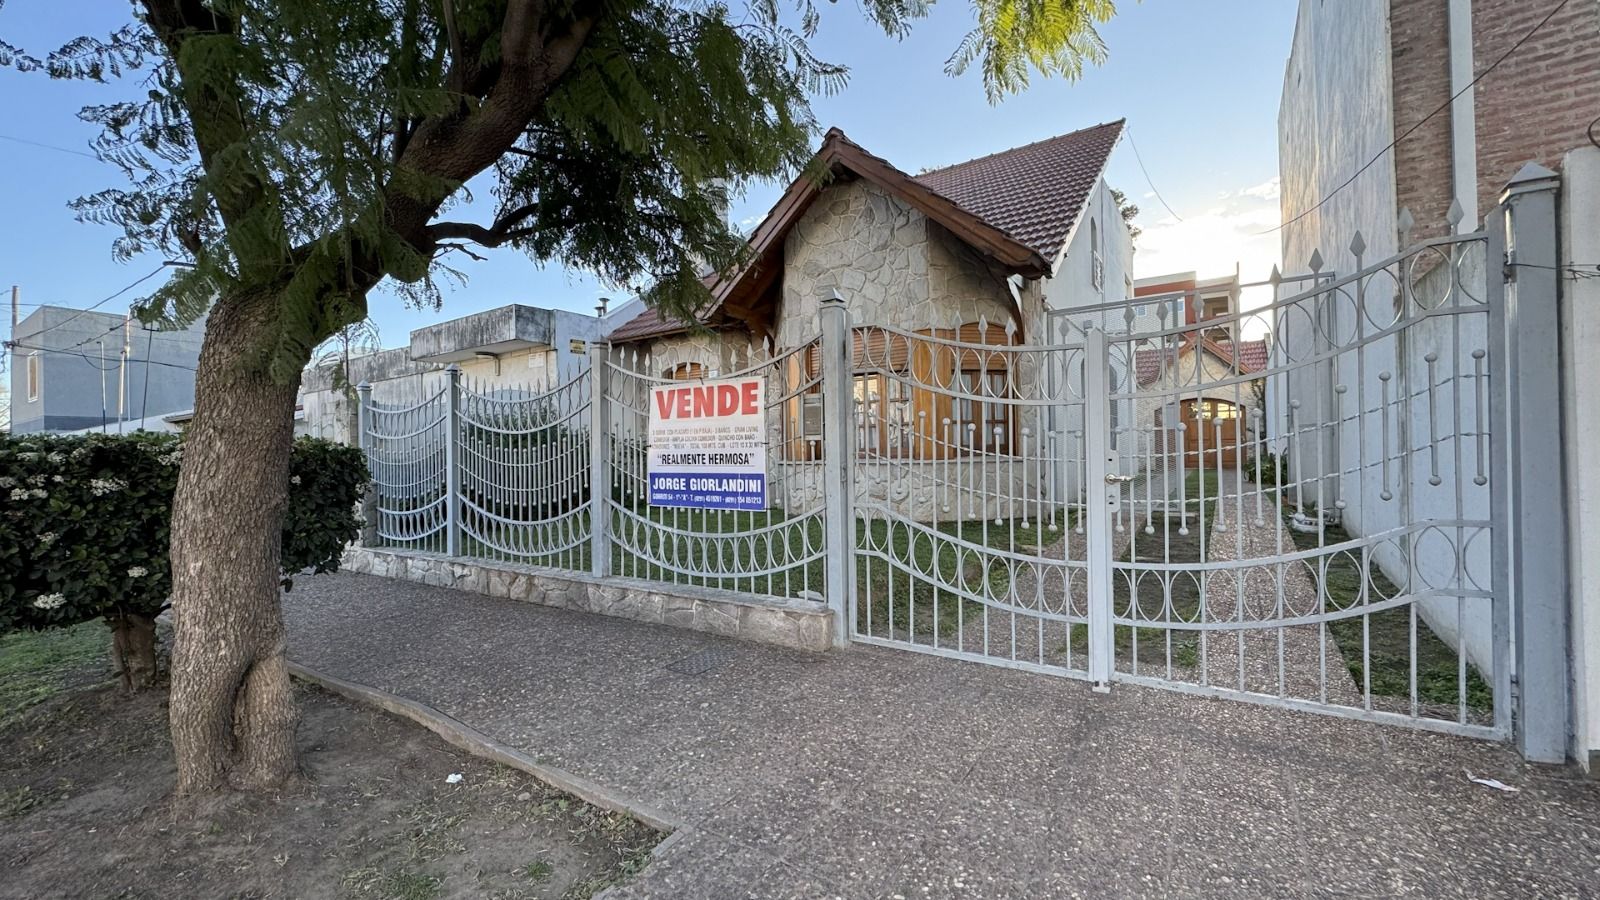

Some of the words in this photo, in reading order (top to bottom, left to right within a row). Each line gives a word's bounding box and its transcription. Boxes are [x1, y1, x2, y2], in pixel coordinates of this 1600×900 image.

[656, 382, 759, 420] VENDE
[657, 453, 706, 464] “REALMENTE
[708, 452, 754, 464] HERMOSA”
[653, 478, 686, 490] JORGE
[690, 478, 762, 492] GIORLANDINI
